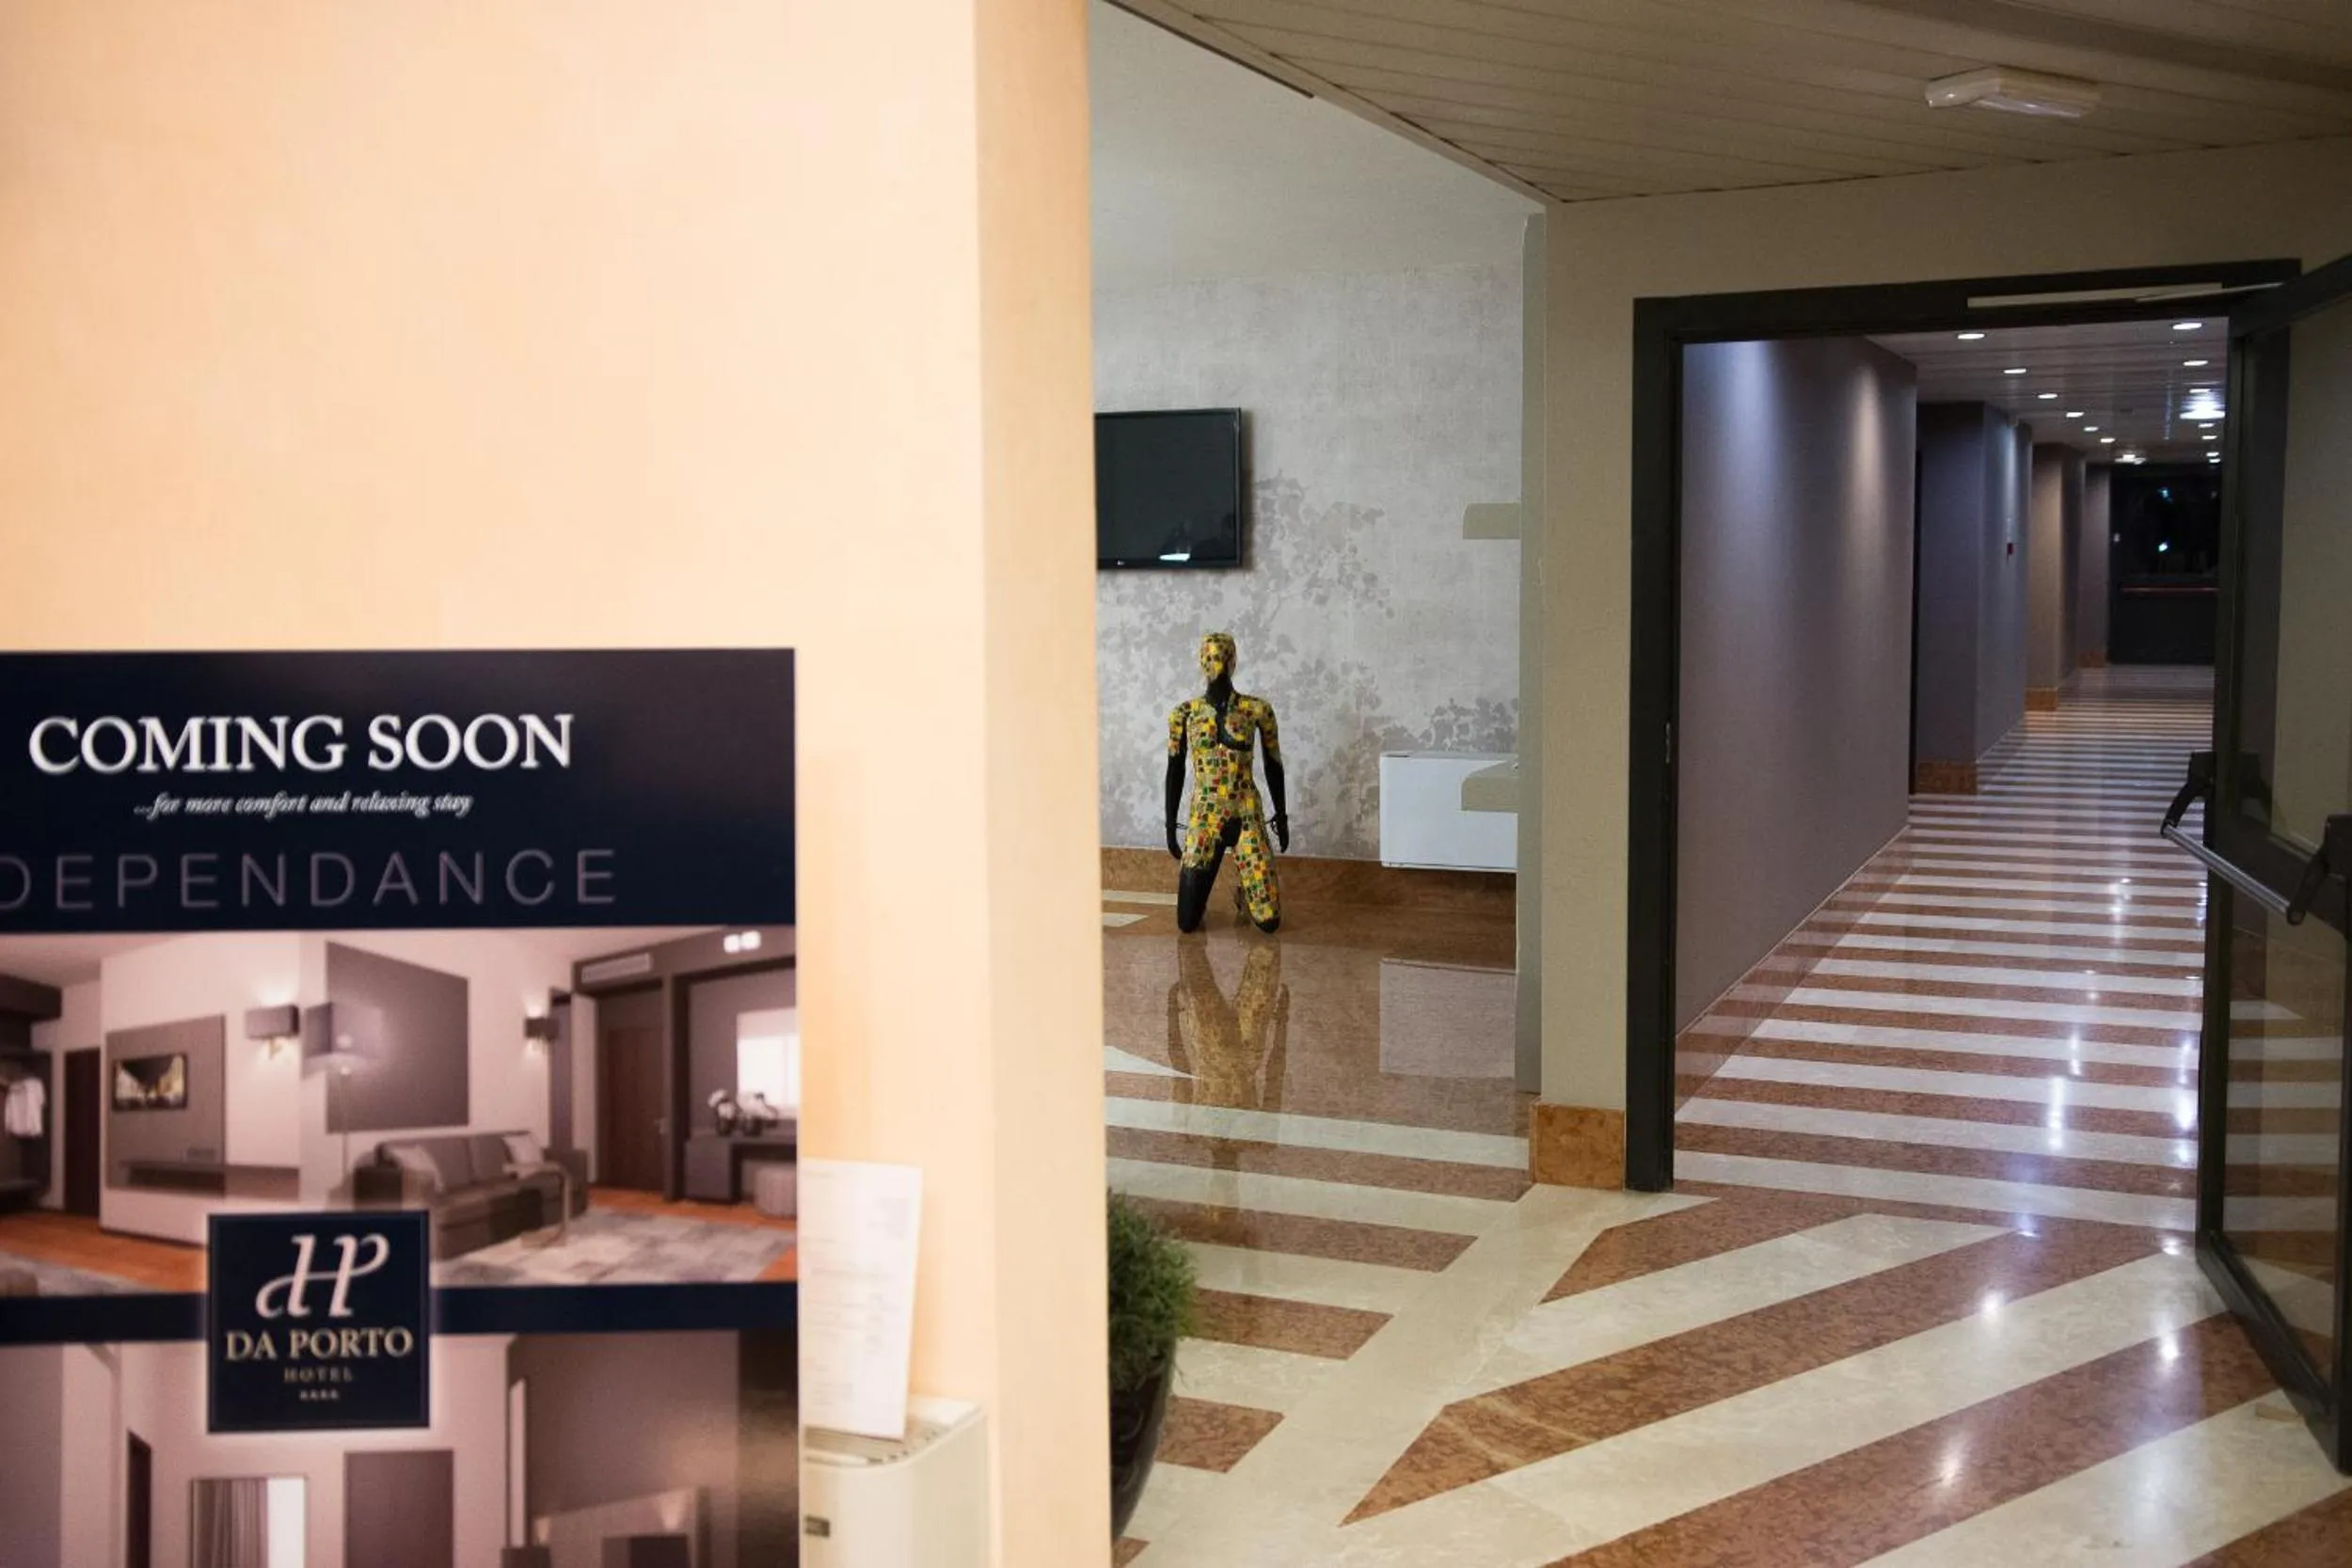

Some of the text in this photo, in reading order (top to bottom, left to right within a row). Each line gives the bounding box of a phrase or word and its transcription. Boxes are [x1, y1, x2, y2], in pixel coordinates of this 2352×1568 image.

[28, 713, 574, 775] COMING SOON
[184, 797, 234, 815] more
[235, 789, 309, 821] comfort
[310, 788, 352, 813] and
[352, 789, 431, 818] relaxing
[432, 792, 473, 818] stay
[0, 848, 616, 911] DEPENDANCE
[226, 1326, 414, 1361] DA PORTO
[283, 1367, 354, 1383] HOTEL
